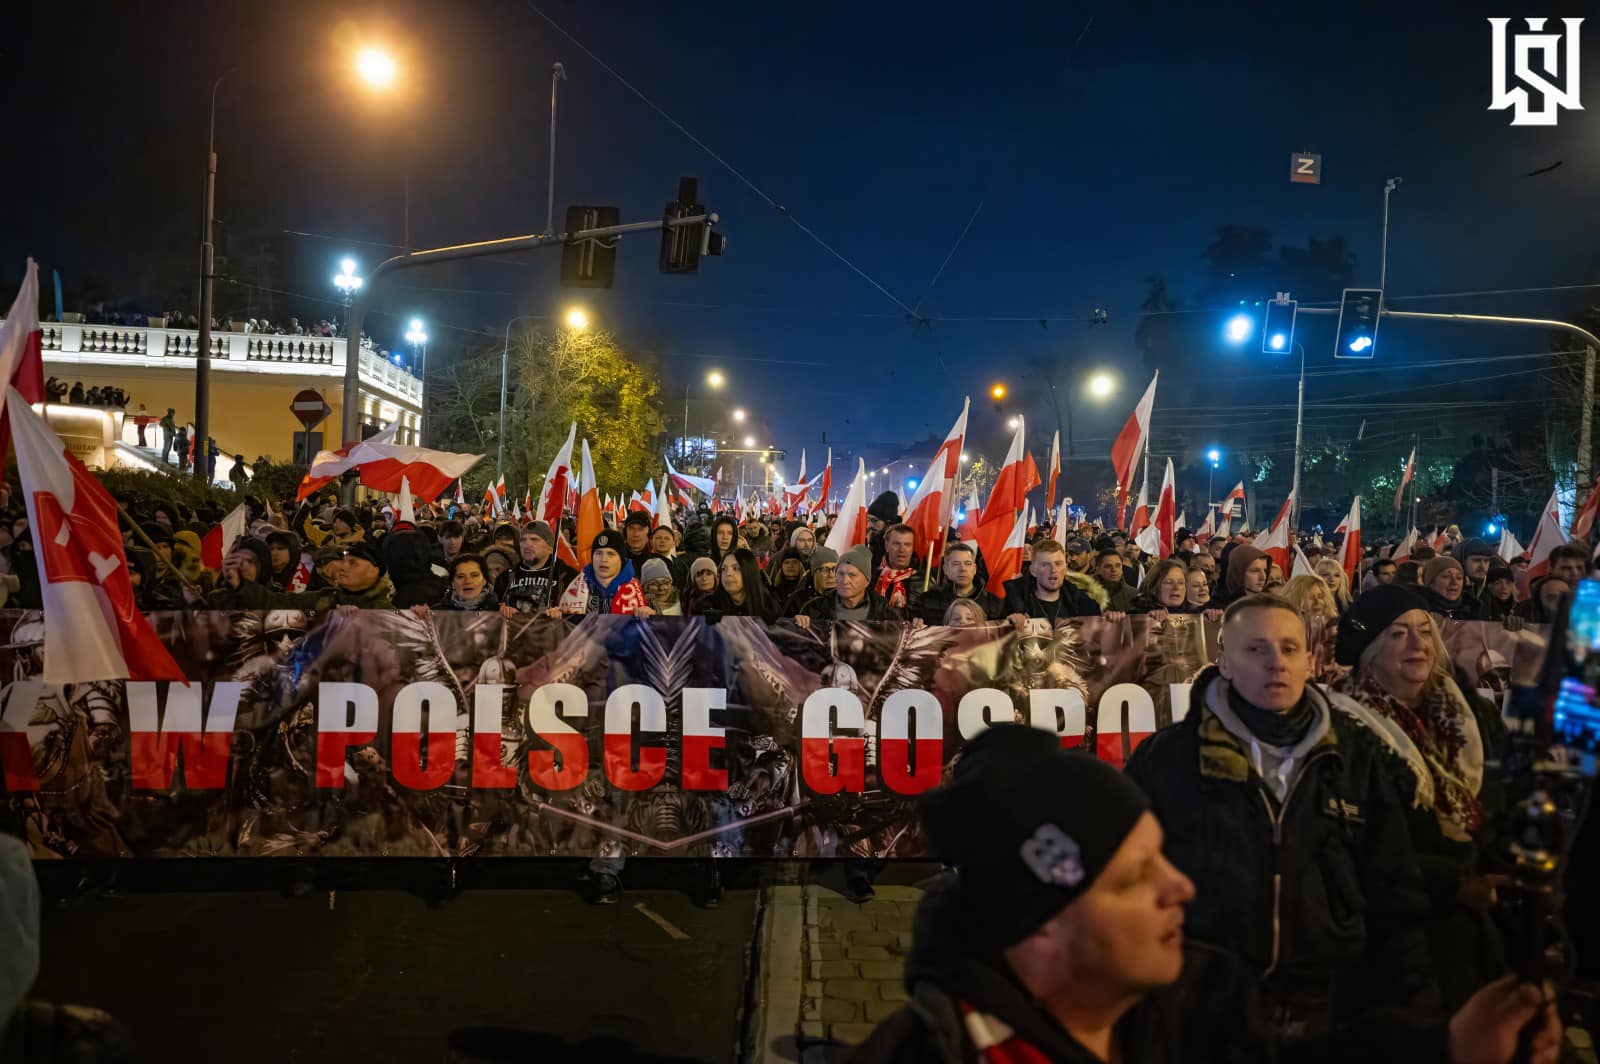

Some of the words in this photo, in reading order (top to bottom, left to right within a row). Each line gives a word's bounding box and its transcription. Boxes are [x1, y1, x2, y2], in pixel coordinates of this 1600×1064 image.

[125, 681, 243, 790] W
[315, 682, 729, 792] POLSCE
[802, 683, 1192, 796] GOSPO
